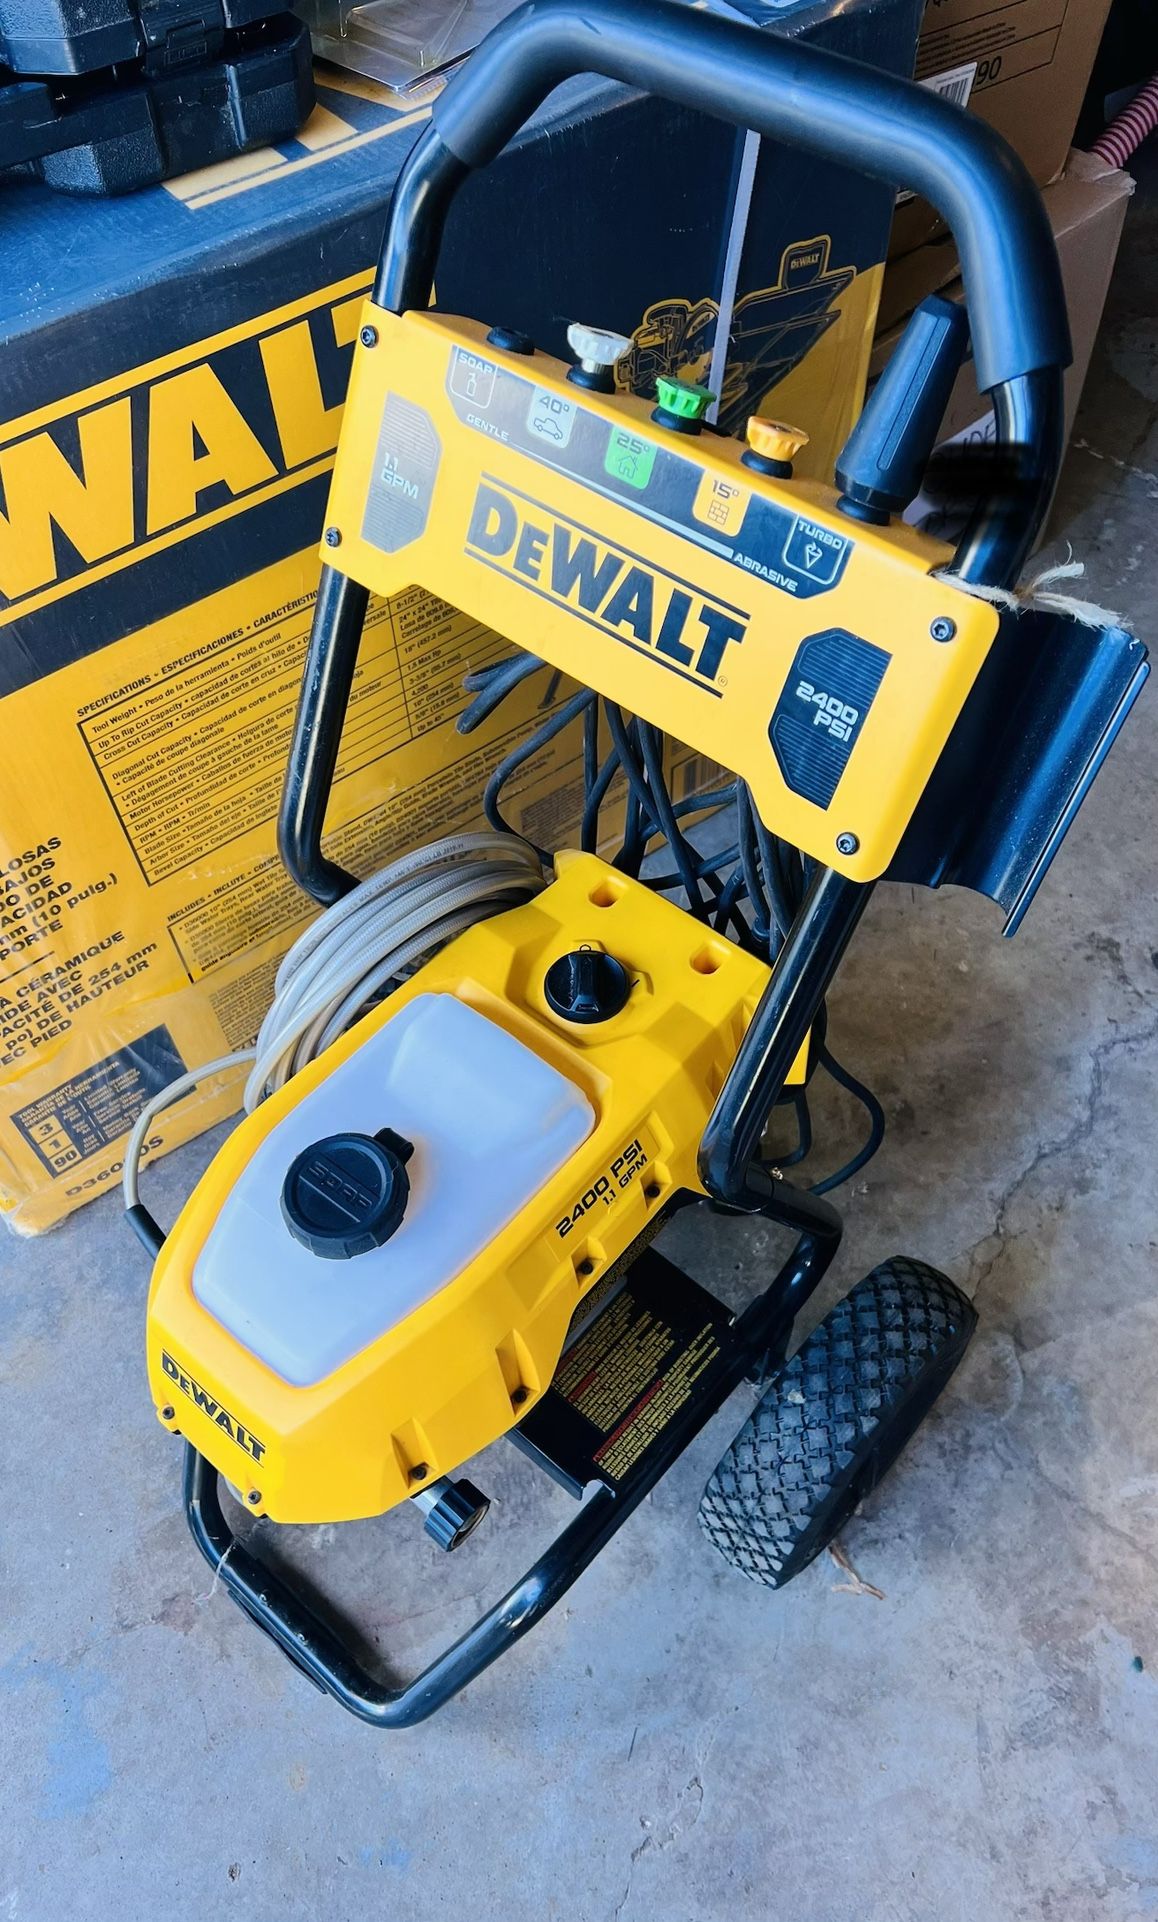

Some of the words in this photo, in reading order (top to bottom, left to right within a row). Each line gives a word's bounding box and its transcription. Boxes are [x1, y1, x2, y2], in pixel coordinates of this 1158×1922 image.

[973, 55, 1002, 86] 90
[458, 351, 493, 375] SOAP
[539, 395, 570, 415] 40°
[466, 413, 510, 442] GENTLE
[616, 432, 650, 455] 25°
[383, 452, 399, 471] 1.1
[380, 468, 420, 500] GPM
[712, 479, 740, 499] 15°
[798, 519, 844, 550] TURBO
[733, 551, 799, 593] ABRASIVE
[77, 675, 151, 717] SPECIFICATIONS
[161, 628, 244, 675] ESPECIFICACIONES
[92, 721, 109, 733] Tool
[109, 707, 137, 724] Weight
[144, 694, 164, 707] Peso
[164, 687, 175, 697] de
[175, 683, 184, 691] la
[184, 660, 230, 687] herramienta
[237, 646, 257, 660] Poids
[258, 633, 281, 649] d'outil
[97, 739, 110, 749] Up
[110, 733, 121, 743] To
[121, 727, 135, 737] Rip
[135, 719, 150, 729] Cut
[150, 702, 182, 722] Capacity
[190, 677, 228, 701] capacidad
[228, 672, 239, 682] de
[240, 660, 262, 676] cortes
[271, 649, 285, 659] hilo
[286, 644, 295, 652] de
[103, 746, 126, 760] Cross
[127, 737, 141, 748] Cut
[141, 721, 173, 741] Capacity
[181, 696, 219, 720] Capacidad
[219, 691, 230, 701] de
[231, 682, 249, 694] corte
[250, 675, 260, 685] en
[260, 667, 276, 679] cruz
[283, 650, 308, 667] Capac
[795, 680, 859, 726] 2400
[112, 758, 145, 780] Diagonal
[146, 751, 160, 762] Cut
[160, 735, 192, 755] Capacity
[199, 710, 237, 734] Capacidad
[237, 705, 248, 715] de
[248, 696, 266, 709] corte
[267, 690, 277, 699] en
[278, 677, 304, 693] diagon
[273, 728, 293, 742] moto
[813, 709, 853, 743] PSI
[121, 790, 137, 801] Left
[138, 785, 145, 793] of
[146, 774, 167, 788] Blade
[168, 760, 195, 776] Cutting
[195, 741, 230, 762] Clearance
[237, 723, 265, 740] Holgura
[264, 716, 275, 725] de
[275, 707, 293, 720] corte
[122, 763, 155, 784] Capacité
[154, 757, 166, 767] de
[166, 746, 189, 761] coupe
[190, 727, 224, 748] diagonale
[263, 744, 291, 762] Profond
[0, 836, 62, 879] LOSAS
[0, 857, 56, 896] AJOS
[0, 881, 73, 928] ACIDAD
[25, 874, 54, 897] DE
[32, 904, 62, 928] (10
[66, 872, 118, 909] pulg.)
[167, 897, 205, 922] INCLUDES
[213, 874, 245, 895] INCLUYE
[0, 918, 63, 961] PORTE
[16, 930, 125, 998] CÉRAMIQUE
[0, 999, 55, 1038] ACITÉ
[58, 983, 85, 1003] DE
[88, 961, 122, 986] 254
[126, 943, 157, 965] mm
[0, 999, 32, 1025] IDE
[37, 969, 83, 1003] AVEC
[5, 1028, 34, 1051] po)
[36, 1010, 63, 1030] DE
[66, 959, 150, 1013] HAUTEUR
[0, 1046, 27, 1066] EC
[30, 1018, 73, 1048] PIED
[18, 1107, 35, 1119] TOOL
[36, 1084, 72, 1108] WARRANTY
[39, 1123, 53, 1136] 3
[49, 1139, 61, 1149] 1
[54, 1150, 77, 1167] 90
[65, 1135, 164, 1196] D3600S
[602, 1188, 617, 1206] 1.1
[618, 1153, 648, 1189] GPM
[555, 1175, 610, 1239] 2400
[610, 1139, 643, 1178] PSI
